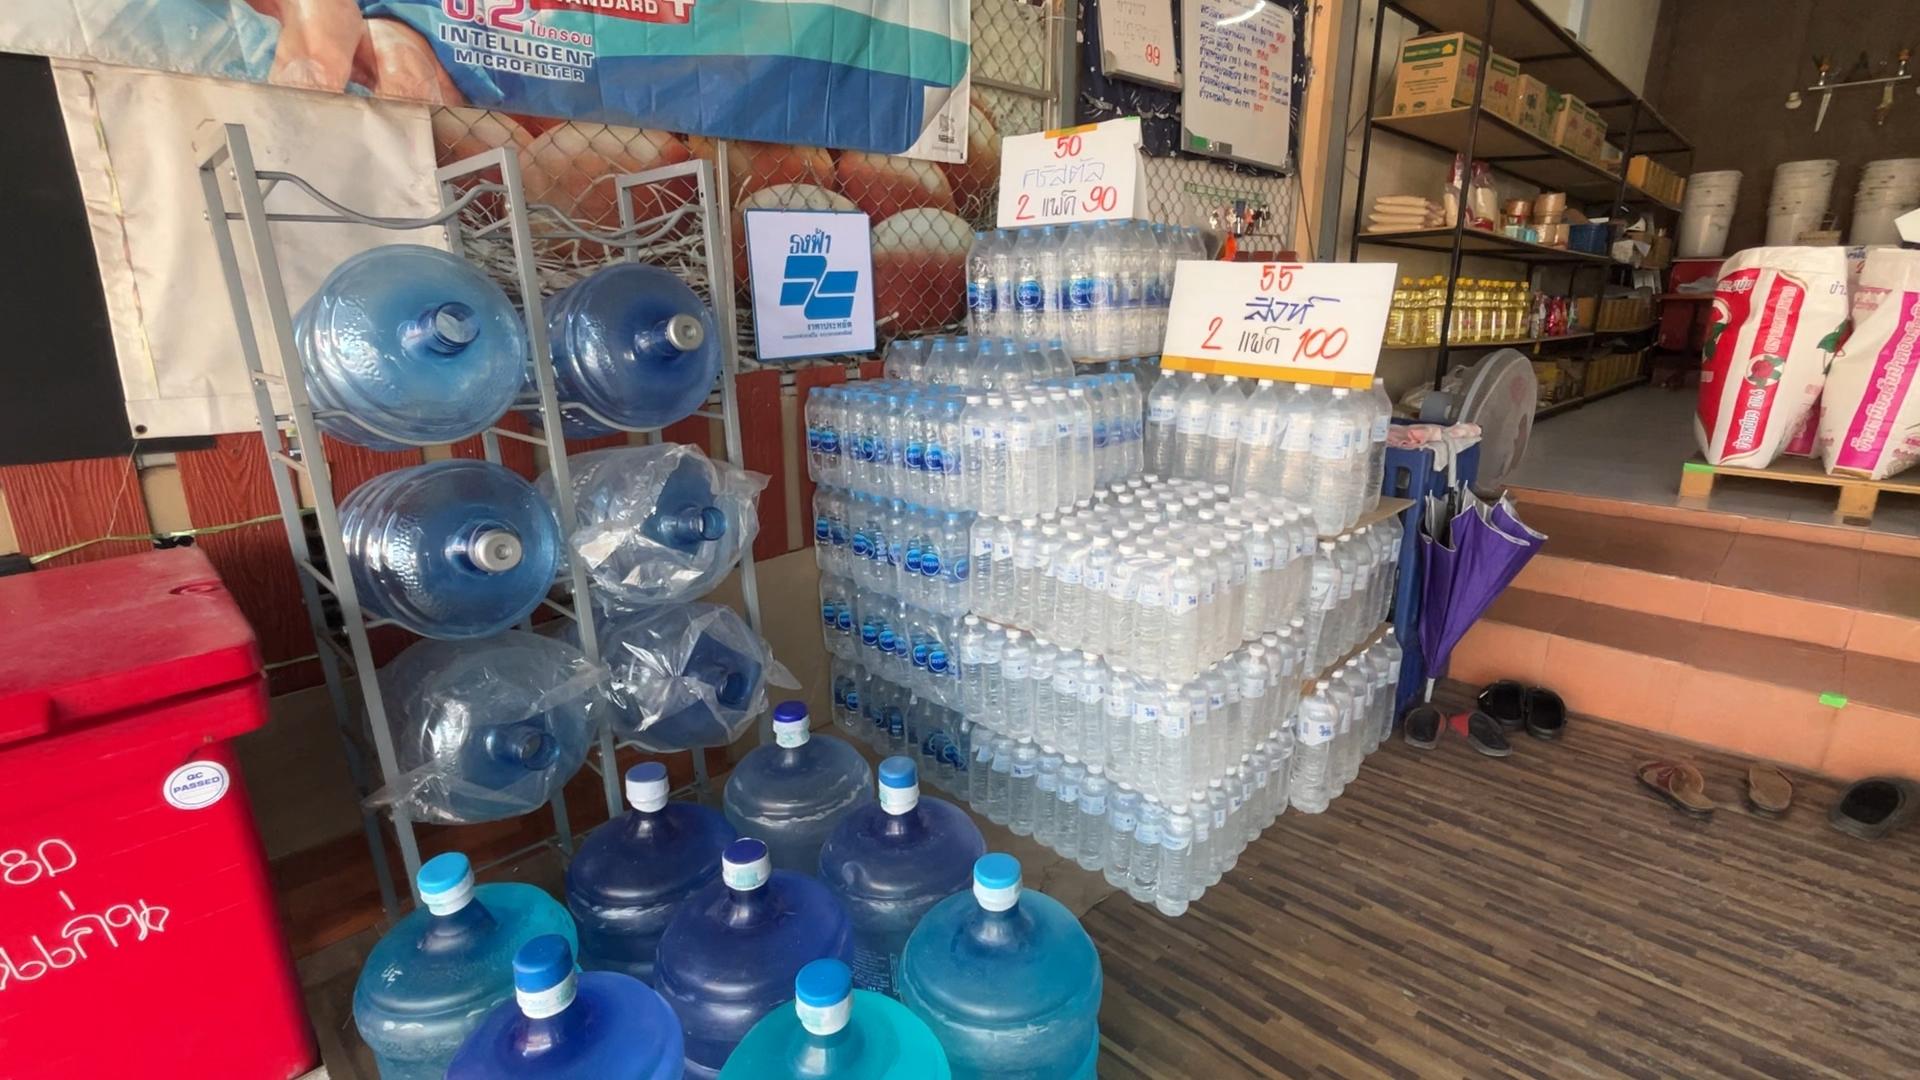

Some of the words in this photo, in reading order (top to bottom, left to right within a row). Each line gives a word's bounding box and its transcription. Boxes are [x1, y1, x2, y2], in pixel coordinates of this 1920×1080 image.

[440, 24, 594, 67] INTELLIGENT
[530, 20, 593, 46] ไมครอน
[455, 49, 585, 82] MICROFILTER
[1054, 135, 1082, 158] 50
[1016, 194, 1035, 220] 2
[1082, 186, 1117, 212] 90
[789, 228, 832, 254] ธงฟ้า
[1260, 265, 1303, 291] 55
[1201, 316, 1222, 350] 2
[1293, 327, 1348, 361] 100
[173, 776, 220, 794] PASSED
[187, 772, 204, 781] QC
